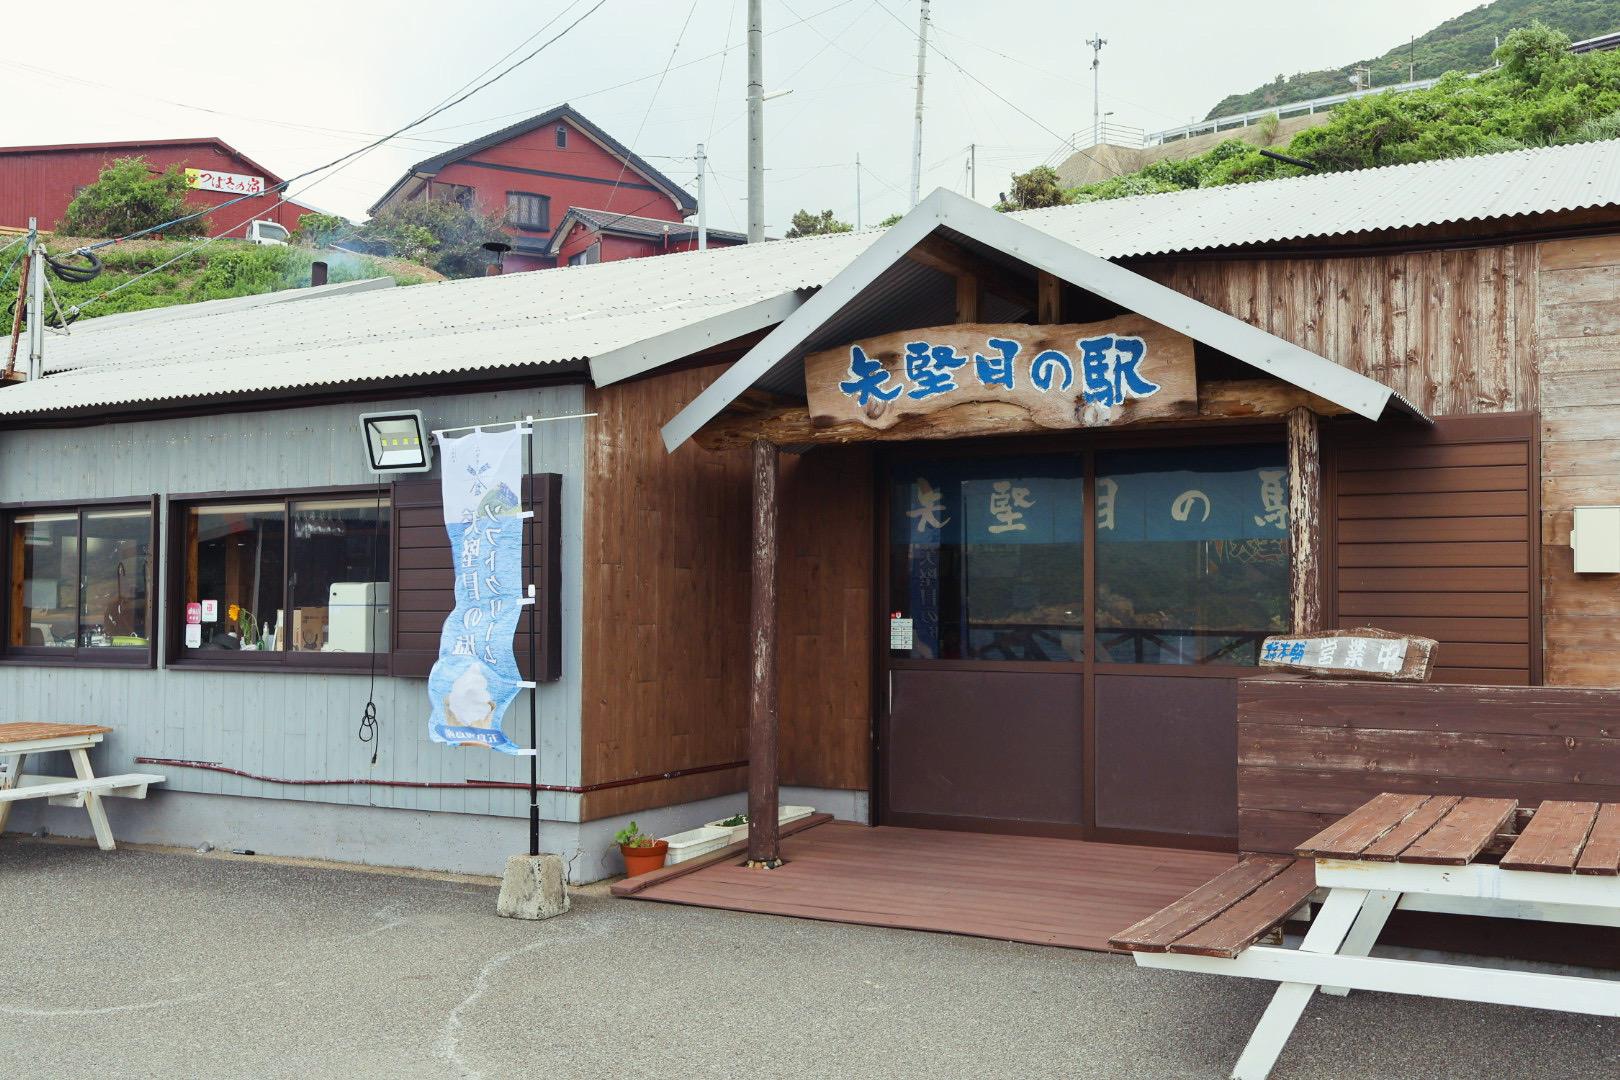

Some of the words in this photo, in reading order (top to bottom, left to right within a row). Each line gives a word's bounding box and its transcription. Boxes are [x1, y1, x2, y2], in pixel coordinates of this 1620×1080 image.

[838, 333, 1161, 409] 矢堅目の駅
[1318, 638, 1402, 670] 営業中
